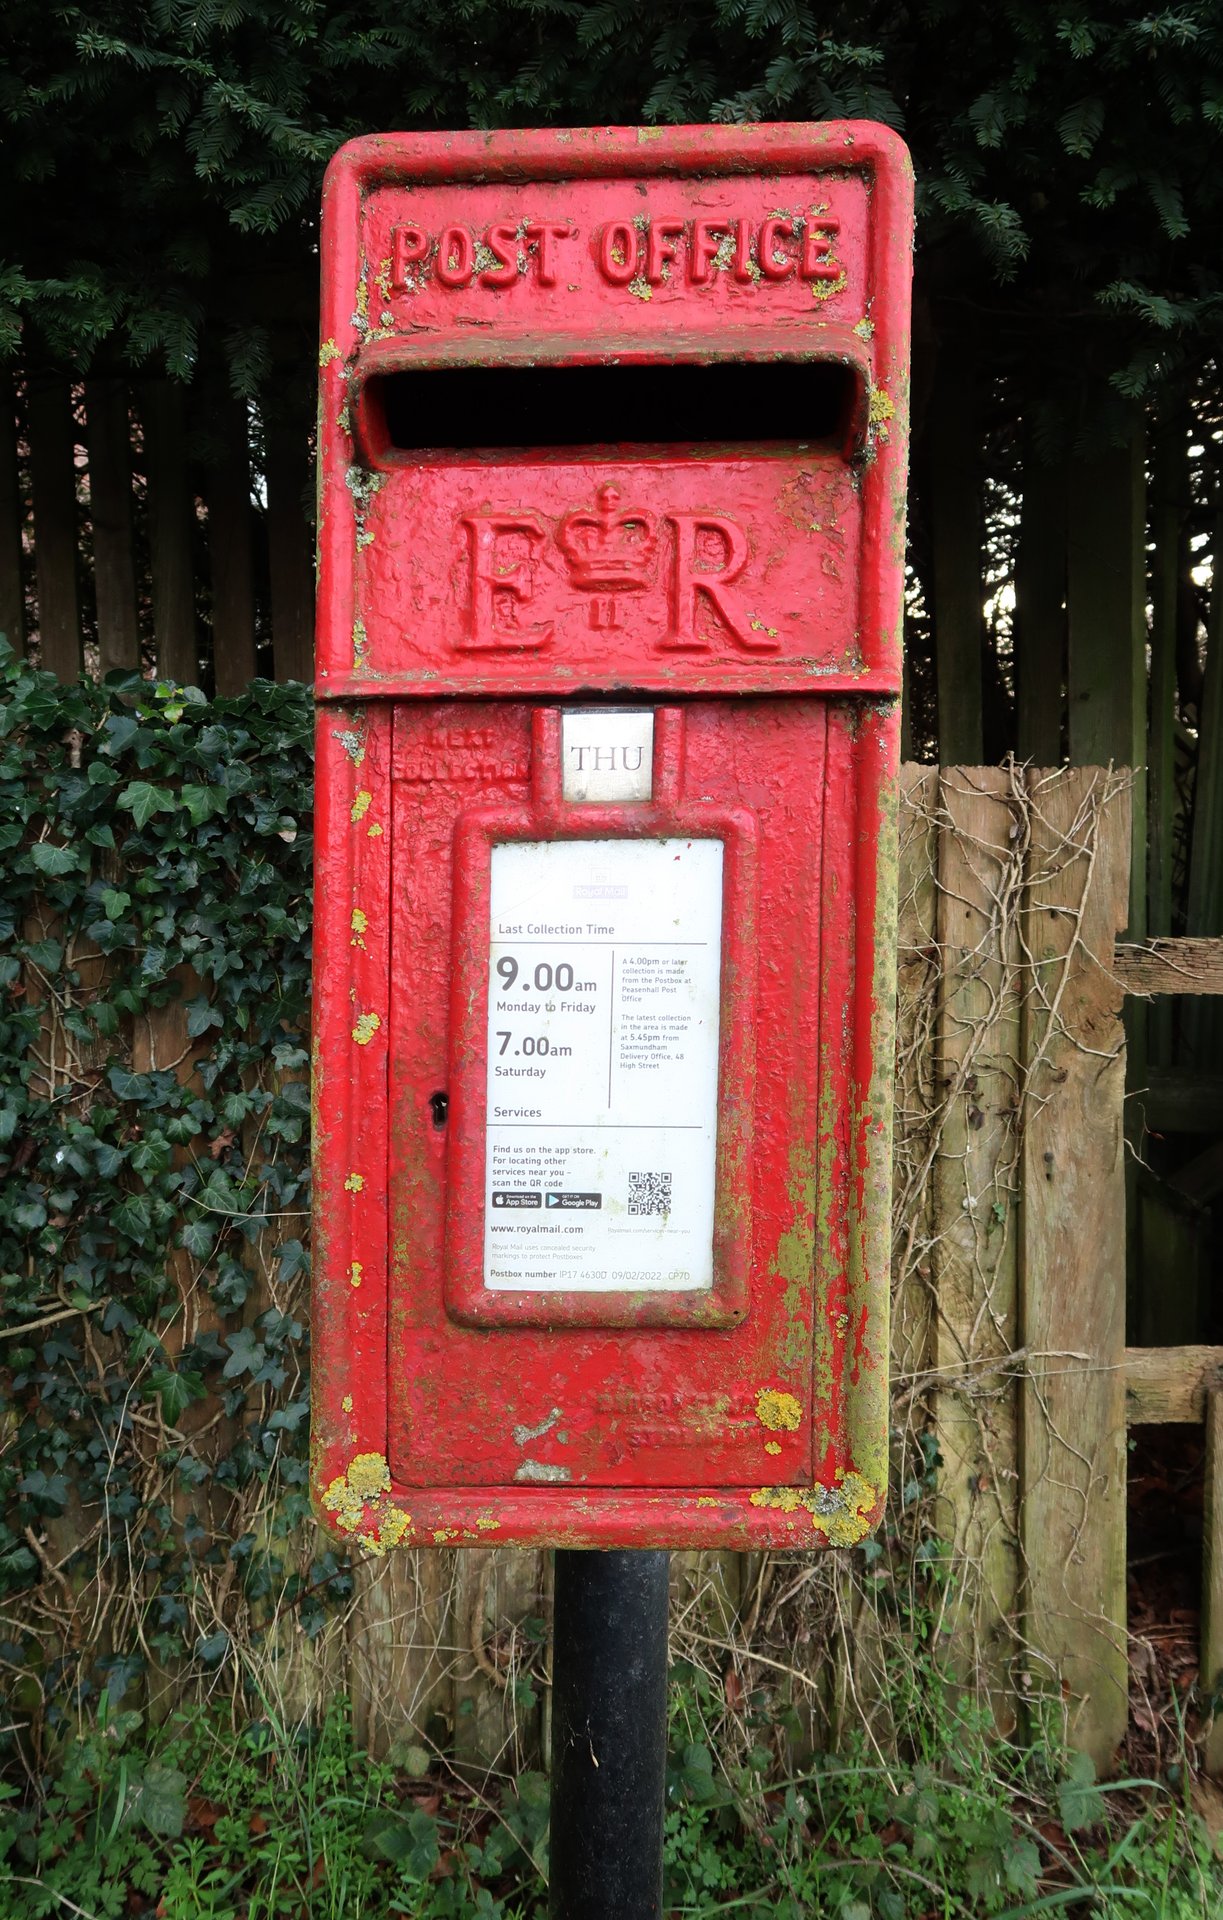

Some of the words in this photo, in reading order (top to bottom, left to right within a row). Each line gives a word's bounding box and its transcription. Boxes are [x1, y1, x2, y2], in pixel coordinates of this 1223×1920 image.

[391, 222, 569, 293] POST
[598, 215, 840, 287] OFFICE
[455, 511, 554, 653] E
[655, 510, 780, 653] R
[570, 745, 645, 772] THU
[576, 887, 603, 898] Royal
[604, 887, 626, 897] Mail
[498, 923, 523, 934] Last
[527, 924, 583, 934] Collection
[586, 924, 615, 934] Time
[629, 957, 660, 966] 4.00pm
[496, 956, 597, 991] 9.00am
[496, 1001, 541, 1013] Monday
[545, 1001, 556, 1012] to
[560, 1002, 596, 1014] Friday
[630, 1033, 661, 1042] 5.45pm
[496, 1031, 572, 1056] 7.00am
[620, 1043, 668, 1051] Saxmundham
[620, 1053, 648, 1061] Delivery
[620, 1062, 636, 1070] High
[495, 1065, 546, 1079] Saturday
[494, 1106, 542, 1117] Services
[493, 1145, 511, 1153] Find
[493, 1156, 506, 1164] For
[509, 1156, 541, 1166] locating
[544, 1157, 567, 1165] other
[492, 1168, 526, 1176] services
[530, 1179, 541, 1187] QR
[544, 1179, 563, 1187] code
[506, 1198, 520, 1206] App
[520, 1198, 538, 1206] Store
[562, 1199, 584, 1208] Google
[586, 1199, 598, 1208] Play
[490, 1224, 584, 1234] www.royalmail.com
[490, 1269, 522, 1277] Postbox
[525, 1270, 557, 1278] number
[612, 1271, 662, 1280] 09/02/2022
